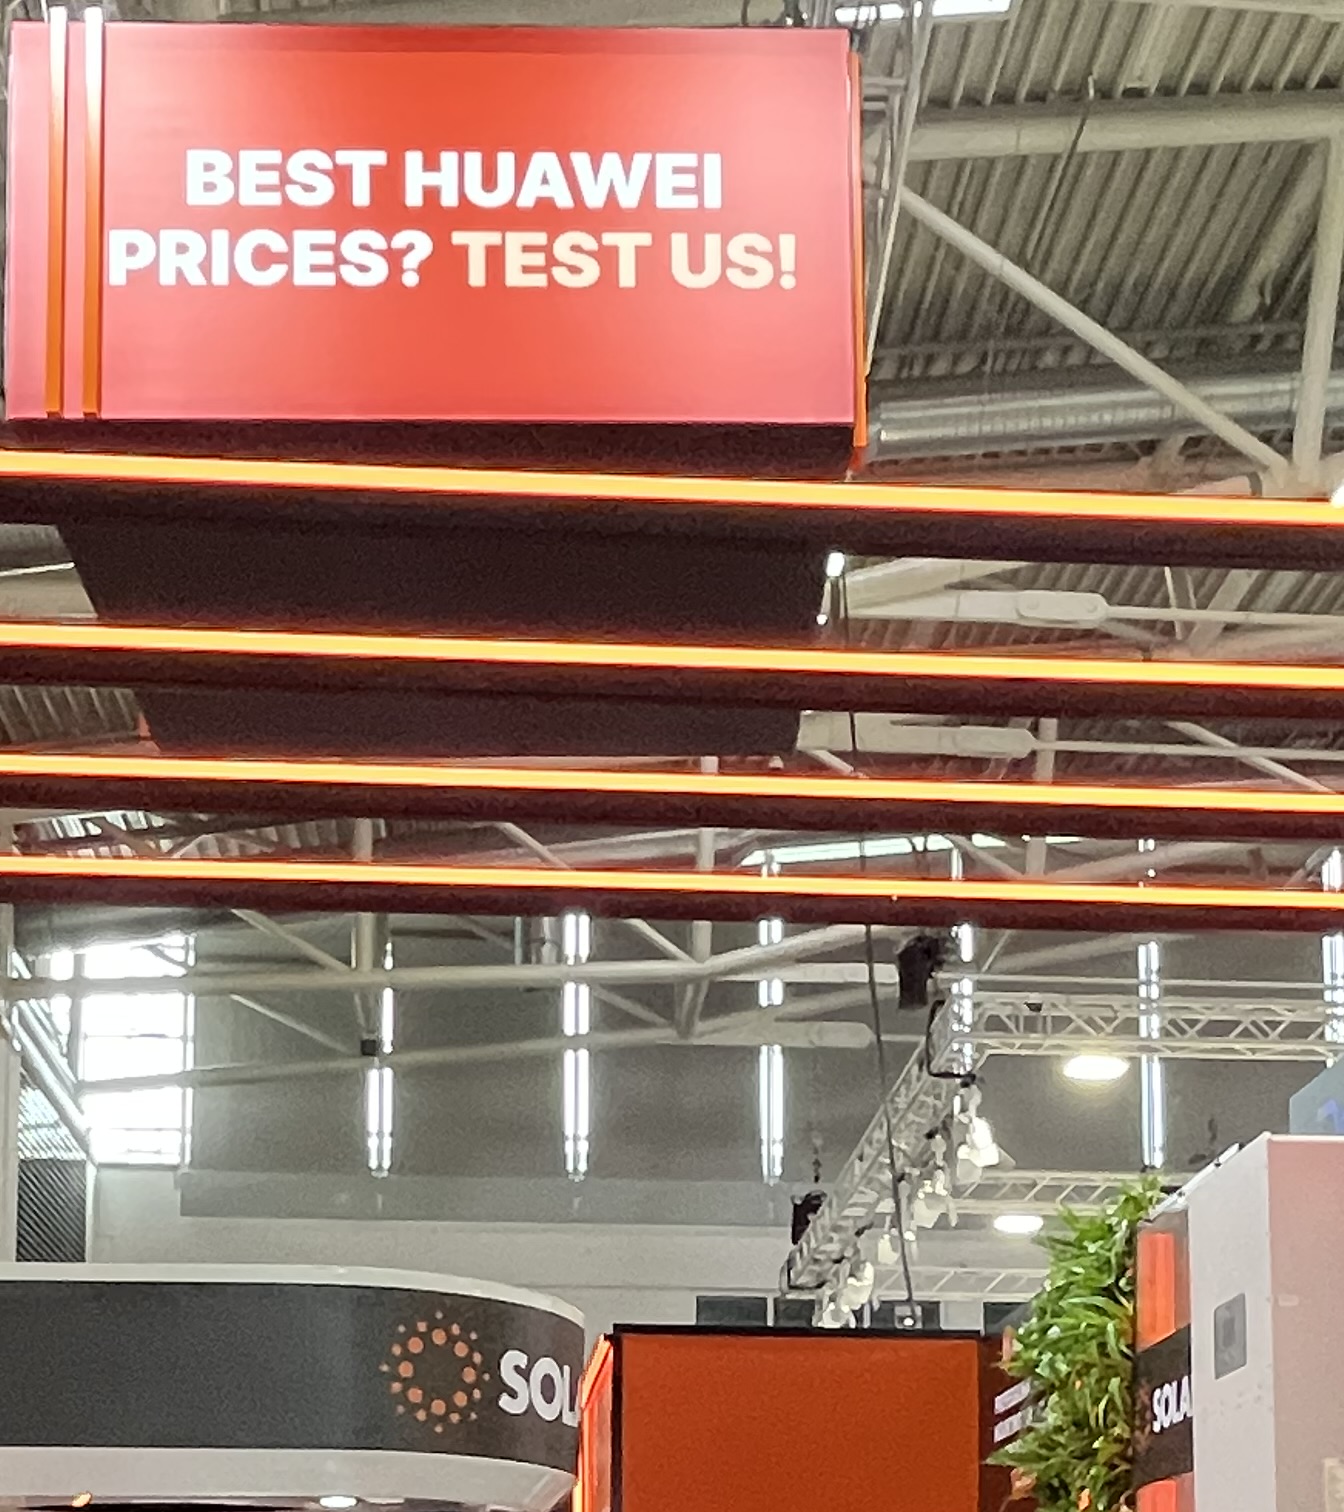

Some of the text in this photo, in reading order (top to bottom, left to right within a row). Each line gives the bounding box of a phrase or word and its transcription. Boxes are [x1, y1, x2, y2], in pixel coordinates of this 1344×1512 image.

[186, 149, 722, 209] BEST HUAWEI
[108, 228, 797, 290] PRICES? TEST US!
